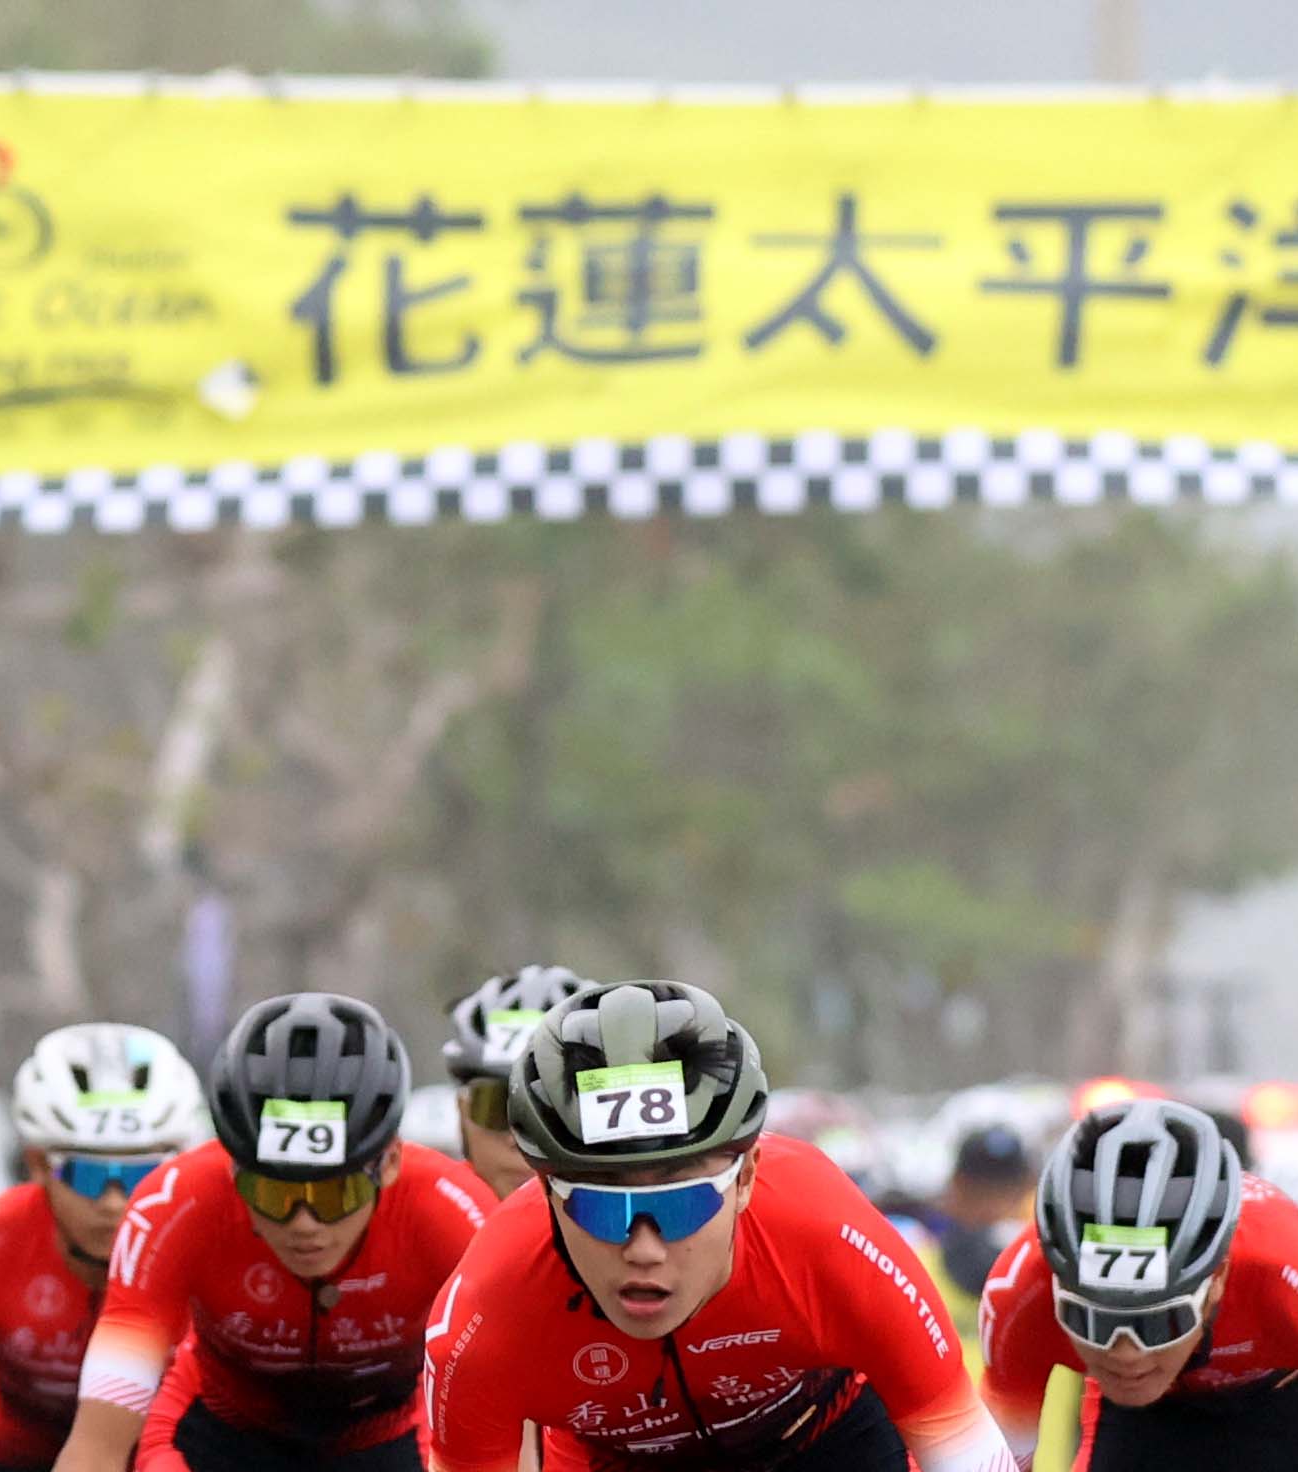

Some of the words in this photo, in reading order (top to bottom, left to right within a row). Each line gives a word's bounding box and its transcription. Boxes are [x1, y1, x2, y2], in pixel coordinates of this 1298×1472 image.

[88, 1106, 142, 1135] 75
[596, 1088, 676, 1130] 78
[274, 1122, 334, 1154] 79
[1094, 1247, 1157, 1281] 77
[840, 1223, 918, 1304] INNOVA
[917, 1296, 950, 1360] TIRE
[439, 1311, 484, 1401] SUNGLASSES
[686, 1328, 782, 1354] VERGE
